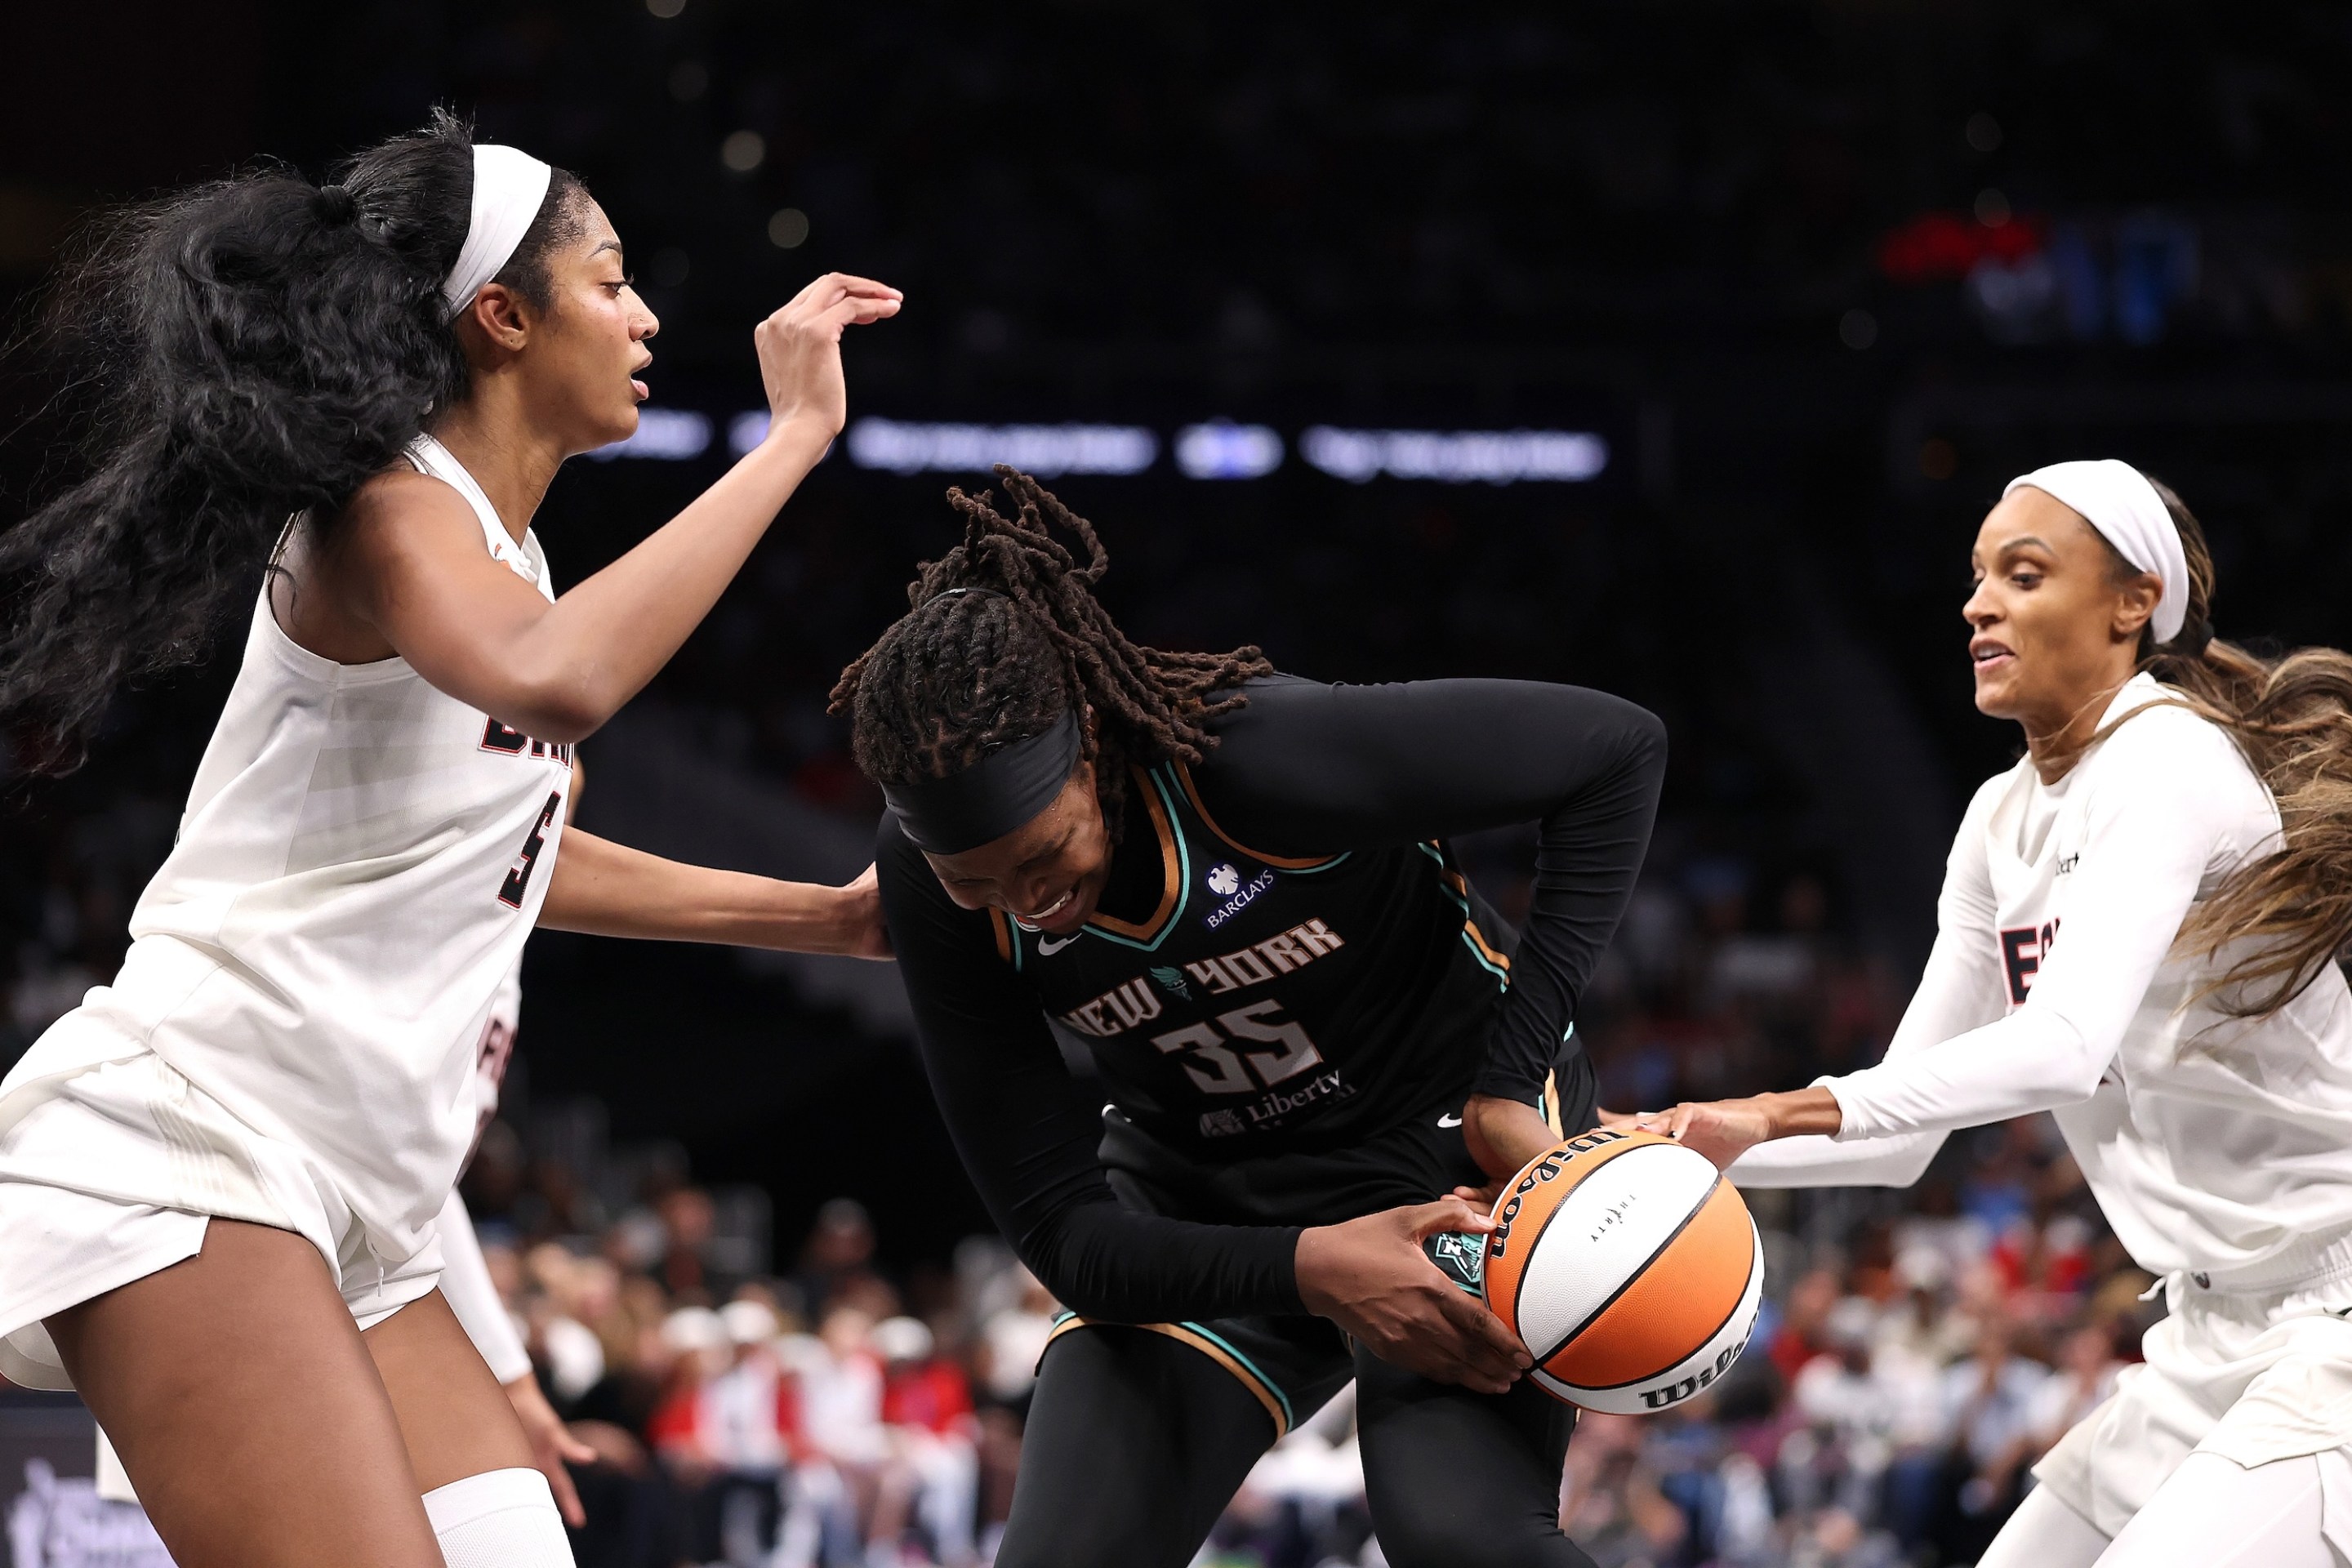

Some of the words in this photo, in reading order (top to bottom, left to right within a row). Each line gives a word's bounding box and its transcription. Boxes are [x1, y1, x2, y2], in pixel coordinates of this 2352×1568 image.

[497, 790, 562, 912] 5
[1207, 869, 1274, 929] BARCLAYS
[1059, 975, 1163, 1037] NEW
[1183, 916, 1346, 995] YORK
[1149, 998, 1325, 1094] 35
[1245, 1068, 1341, 1125] Liberty
[1489, 1129, 1633, 1260] Wilson
